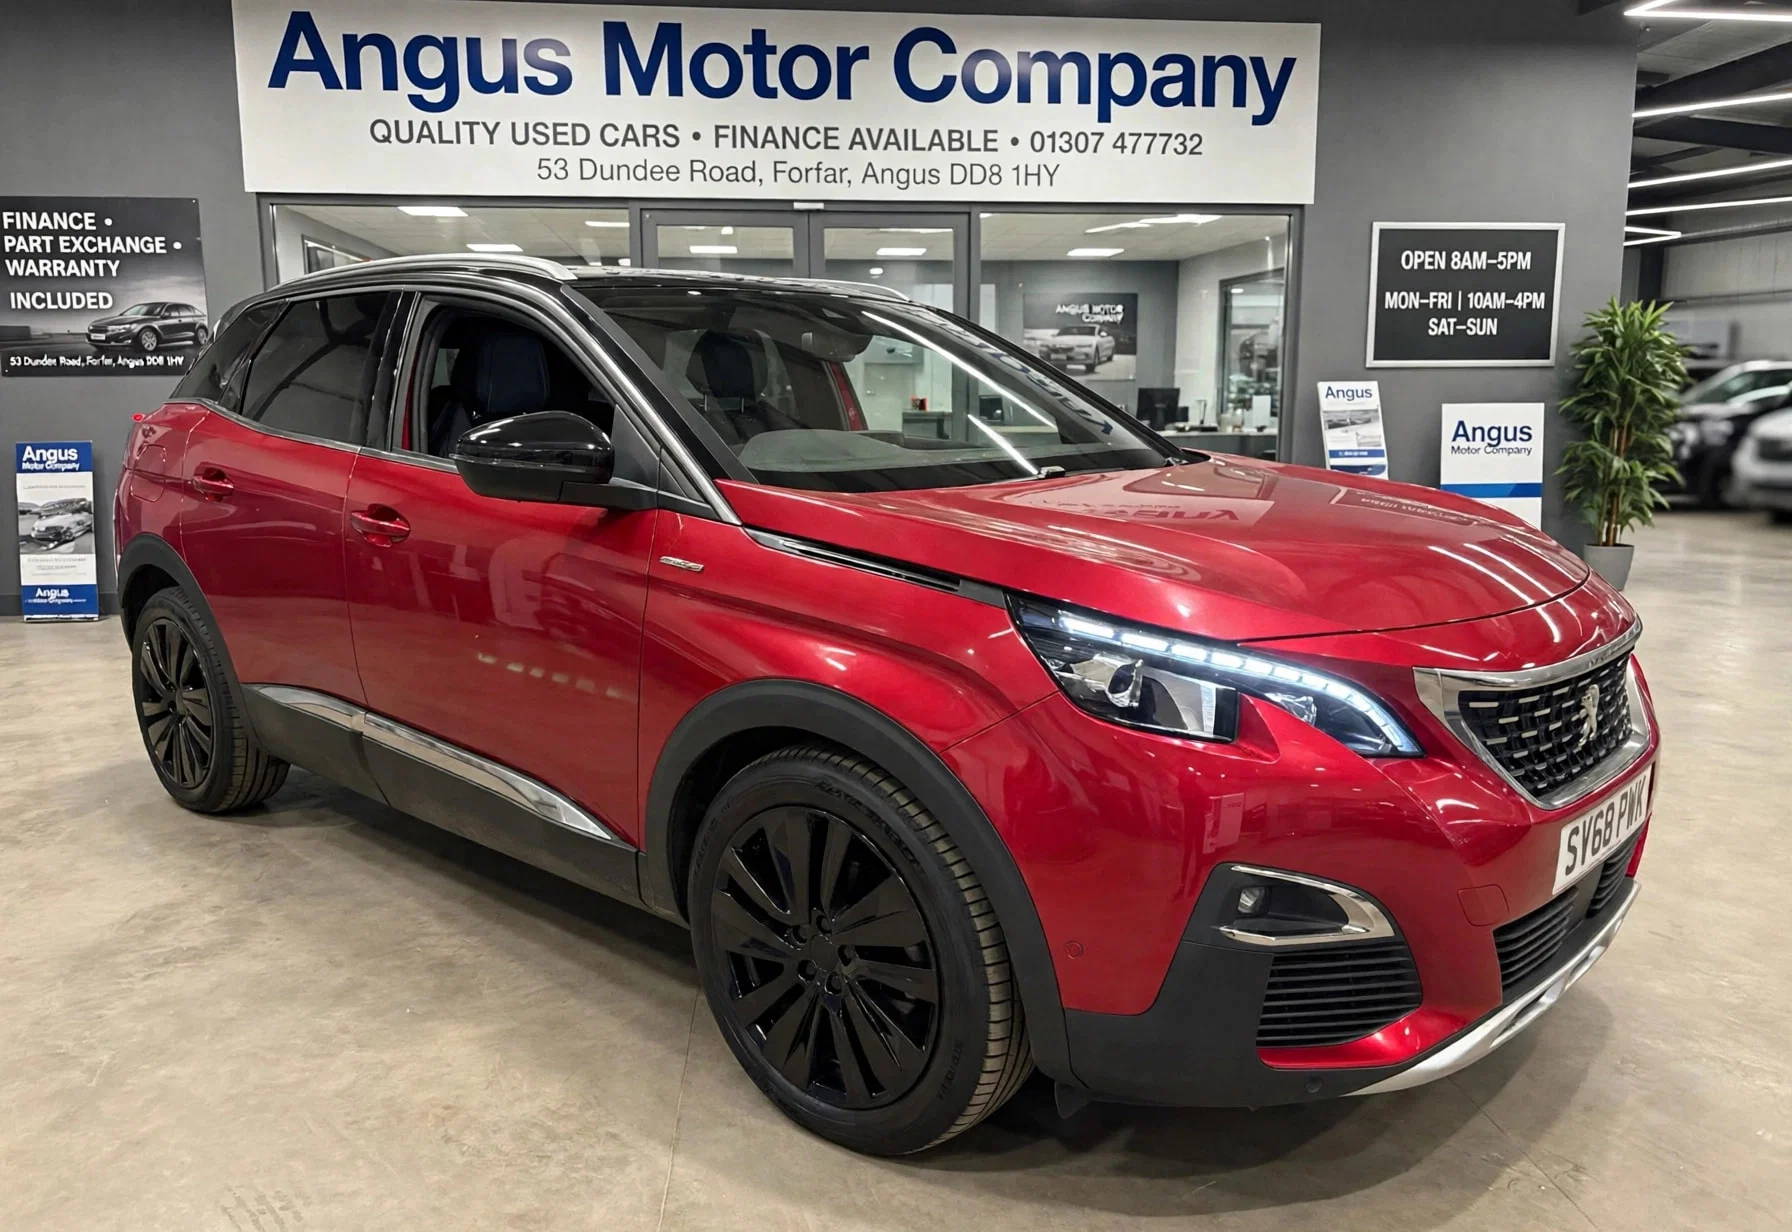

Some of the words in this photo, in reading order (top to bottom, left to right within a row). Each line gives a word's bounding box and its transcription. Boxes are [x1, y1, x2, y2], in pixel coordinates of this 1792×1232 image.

[268, 11, 573, 113] Angus
[603, 21, 870, 101] Motor
[894, 26, 1297, 126] Company
[369, 118, 501, 145] QUALITY
[510, 122, 591, 147] USED
[599, 123, 680, 148] CARS
[714, 125, 840, 150] FINANCE
[848, 127, 999, 153] AVAILABLE
[1030, 130, 1104, 154] 01307
[1112, 131, 1203, 156] 477732
[537, 158, 569, 181] 53
[579, 158, 681, 182] Dundee
[690, 160, 763, 187] Road,
[773, 161, 852, 188] Forfar,
[861, 162, 941, 190] Angus
[950, 162, 1002, 186] DD8
[1011, 163, 1060, 187] 1HY
[2, 212, 97, 230] FINANCE
[4, 236, 54, 253] PART
[59, 236, 167, 254] EXCHANGE
[5, 259, 120, 277] WARRANTY
[1401, 250, 1446, 270] OPEN
[10, 291, 113, 310] INCLUDED
[1325, 385, 1373, 401] Angus
[1451, 420, 1533, 447] Angus
[22, 445, 78, 463] Angus
[1451, 445, 1481, 455] Motor
[1484, 446, 1533, 456] Company
[1565, 802, 1615, 876] SY68
[1616, 775, 1646, 838] PWK
